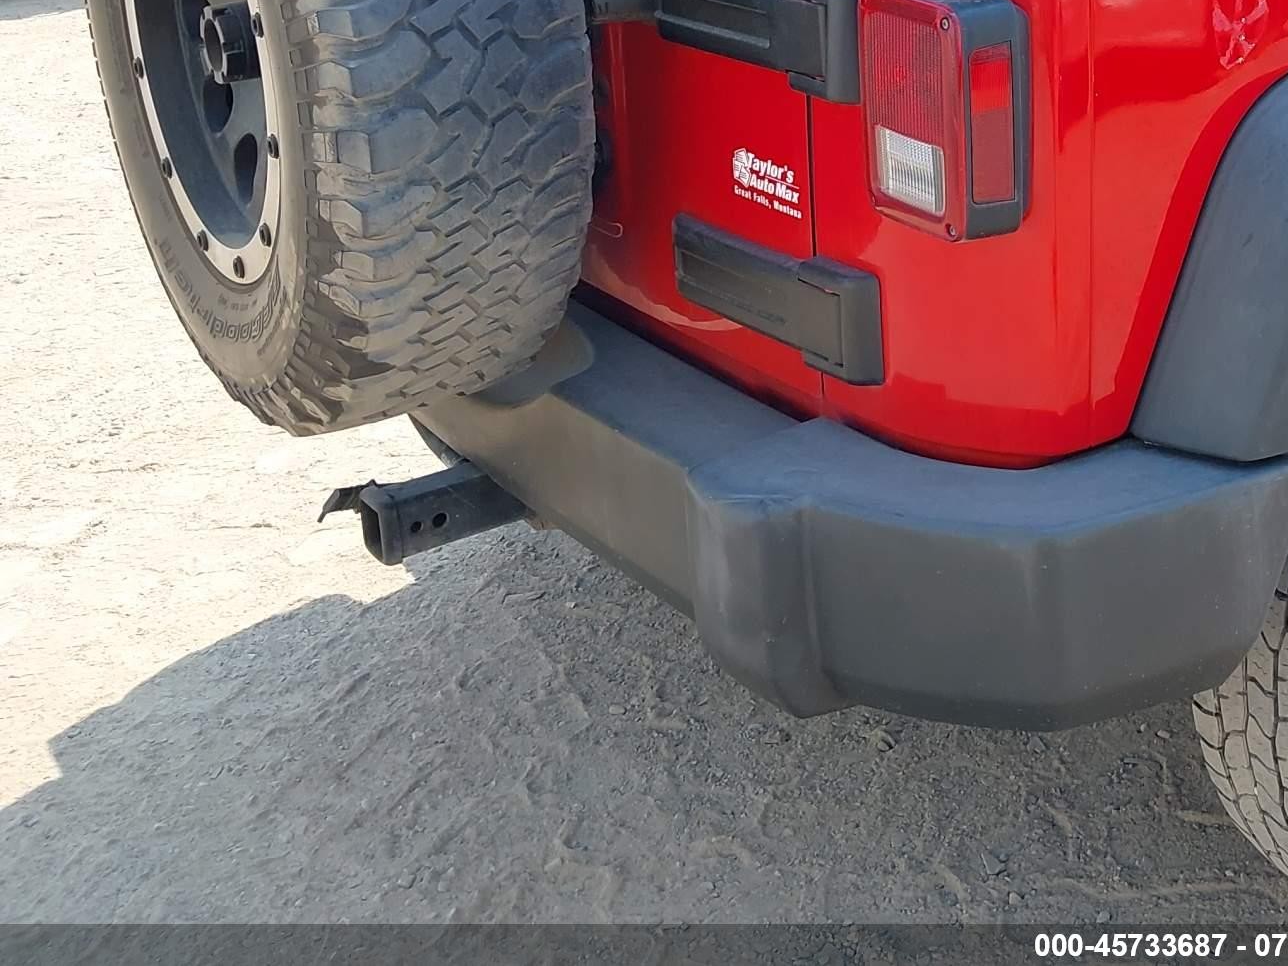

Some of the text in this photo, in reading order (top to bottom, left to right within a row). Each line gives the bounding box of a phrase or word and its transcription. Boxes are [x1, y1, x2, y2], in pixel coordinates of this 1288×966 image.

[747, 151, 795, 185] Taylor's
[734, 184, 752, 201] Great
[773, 200, 802, 219] Montana
